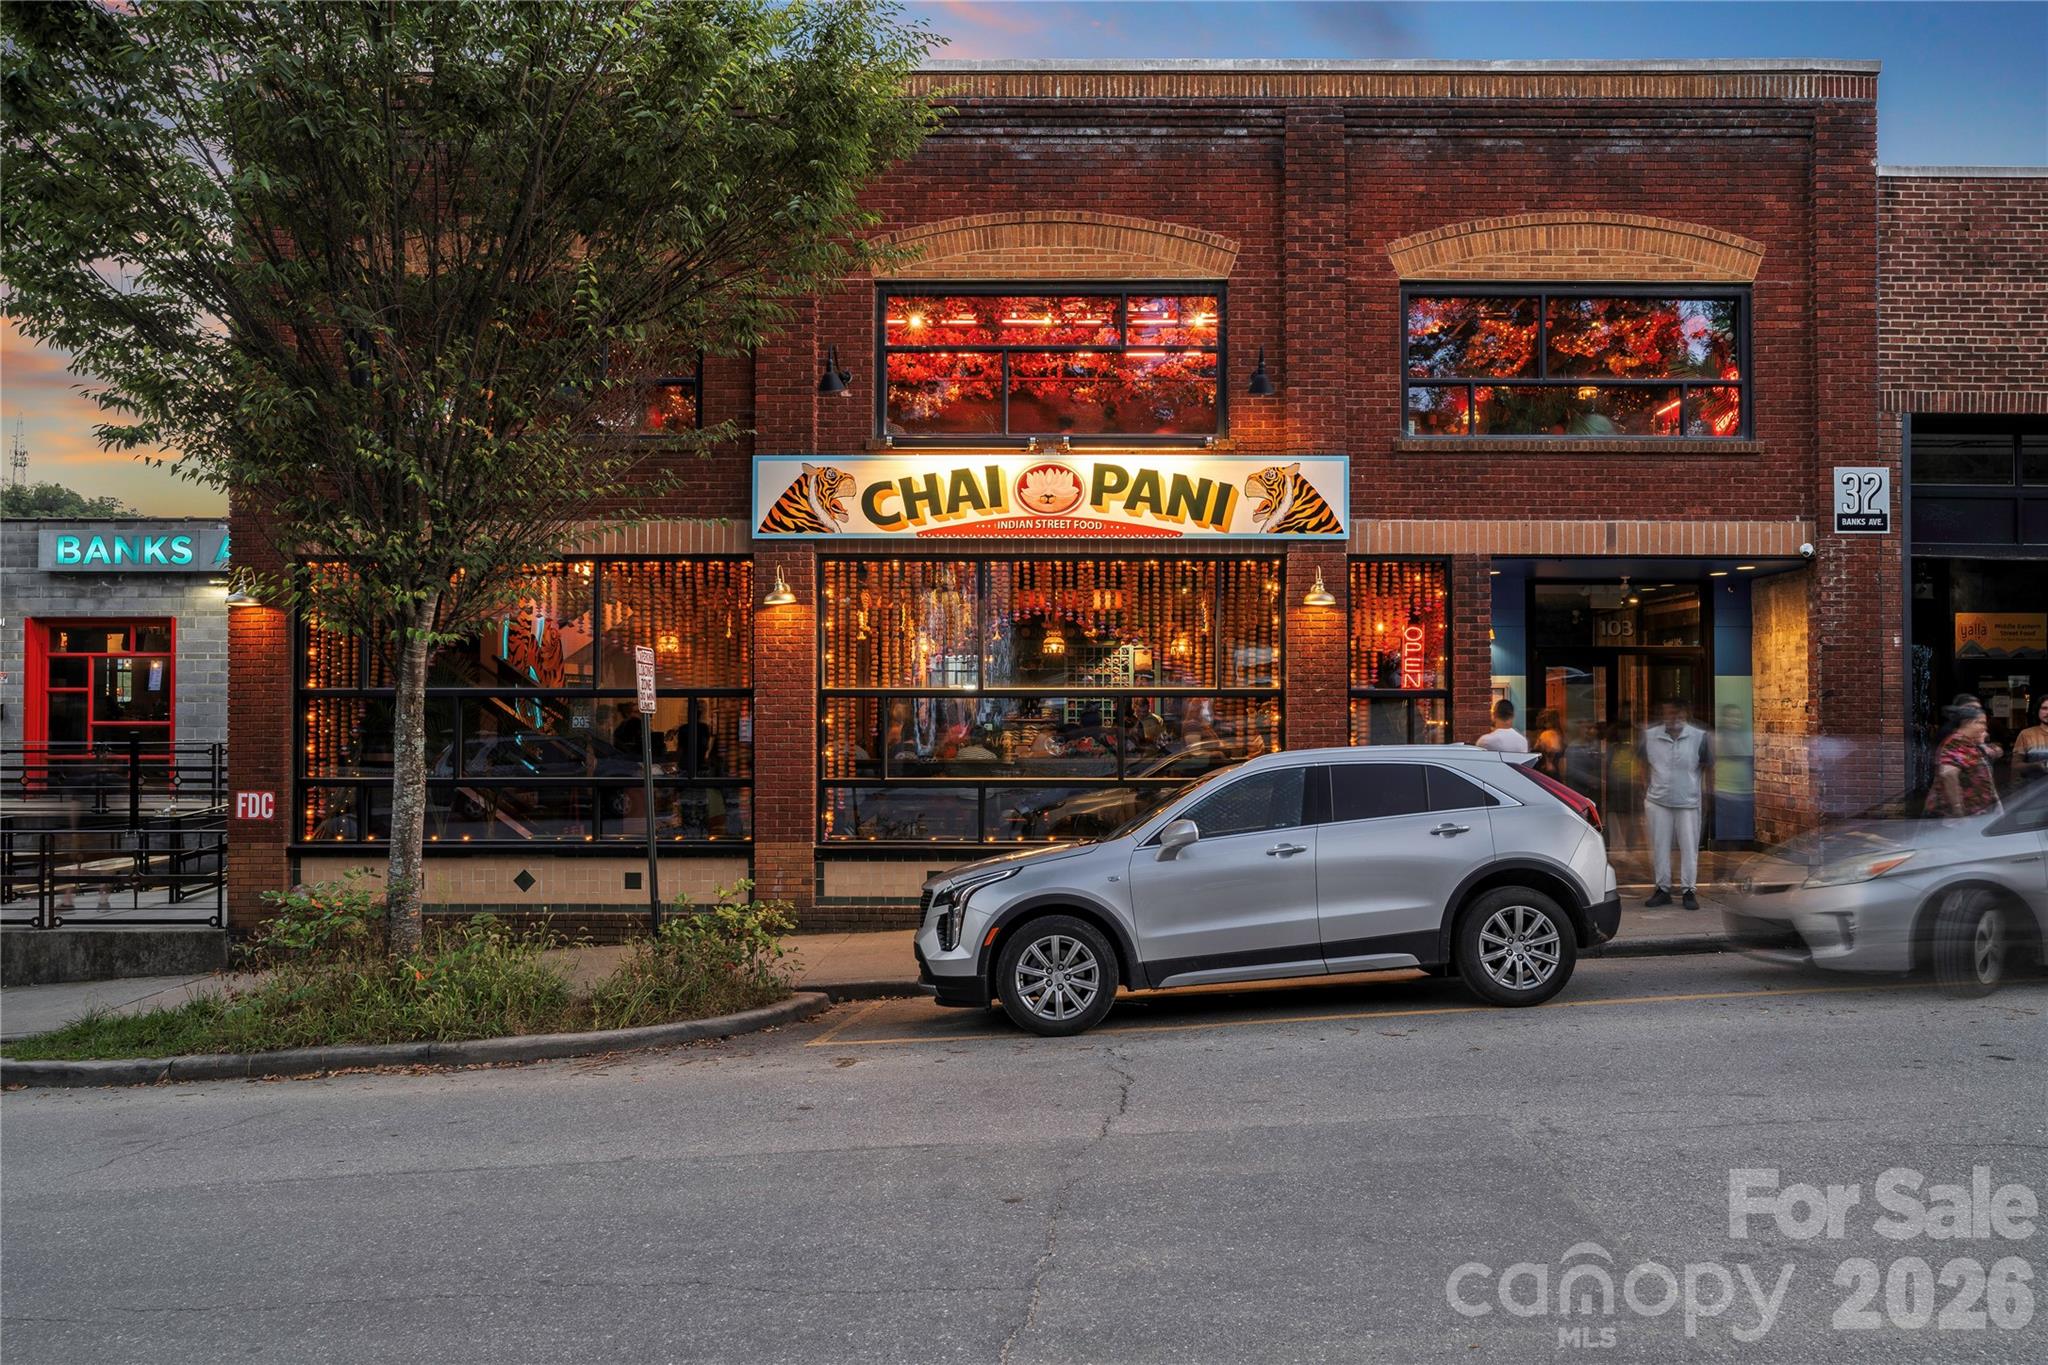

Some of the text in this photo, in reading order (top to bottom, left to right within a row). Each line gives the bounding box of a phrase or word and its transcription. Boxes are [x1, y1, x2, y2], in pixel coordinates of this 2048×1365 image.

[861, 462, 1234, 530] CHAI PANI
[1841, 472, 1882, 514] 32
[997, 519, 1103, 531] INDIAN STREET FOOD
[1841, 518, 1884, 526] BANKS AVE.
[56, 534, 194, 565] BANKS
[1600, 620, 1634, 636] 103
[1961, 623, 1988, 640] yalla
[1404, 626, 1423, 688] OPEN
[237, 792, 274, 819] FDC
